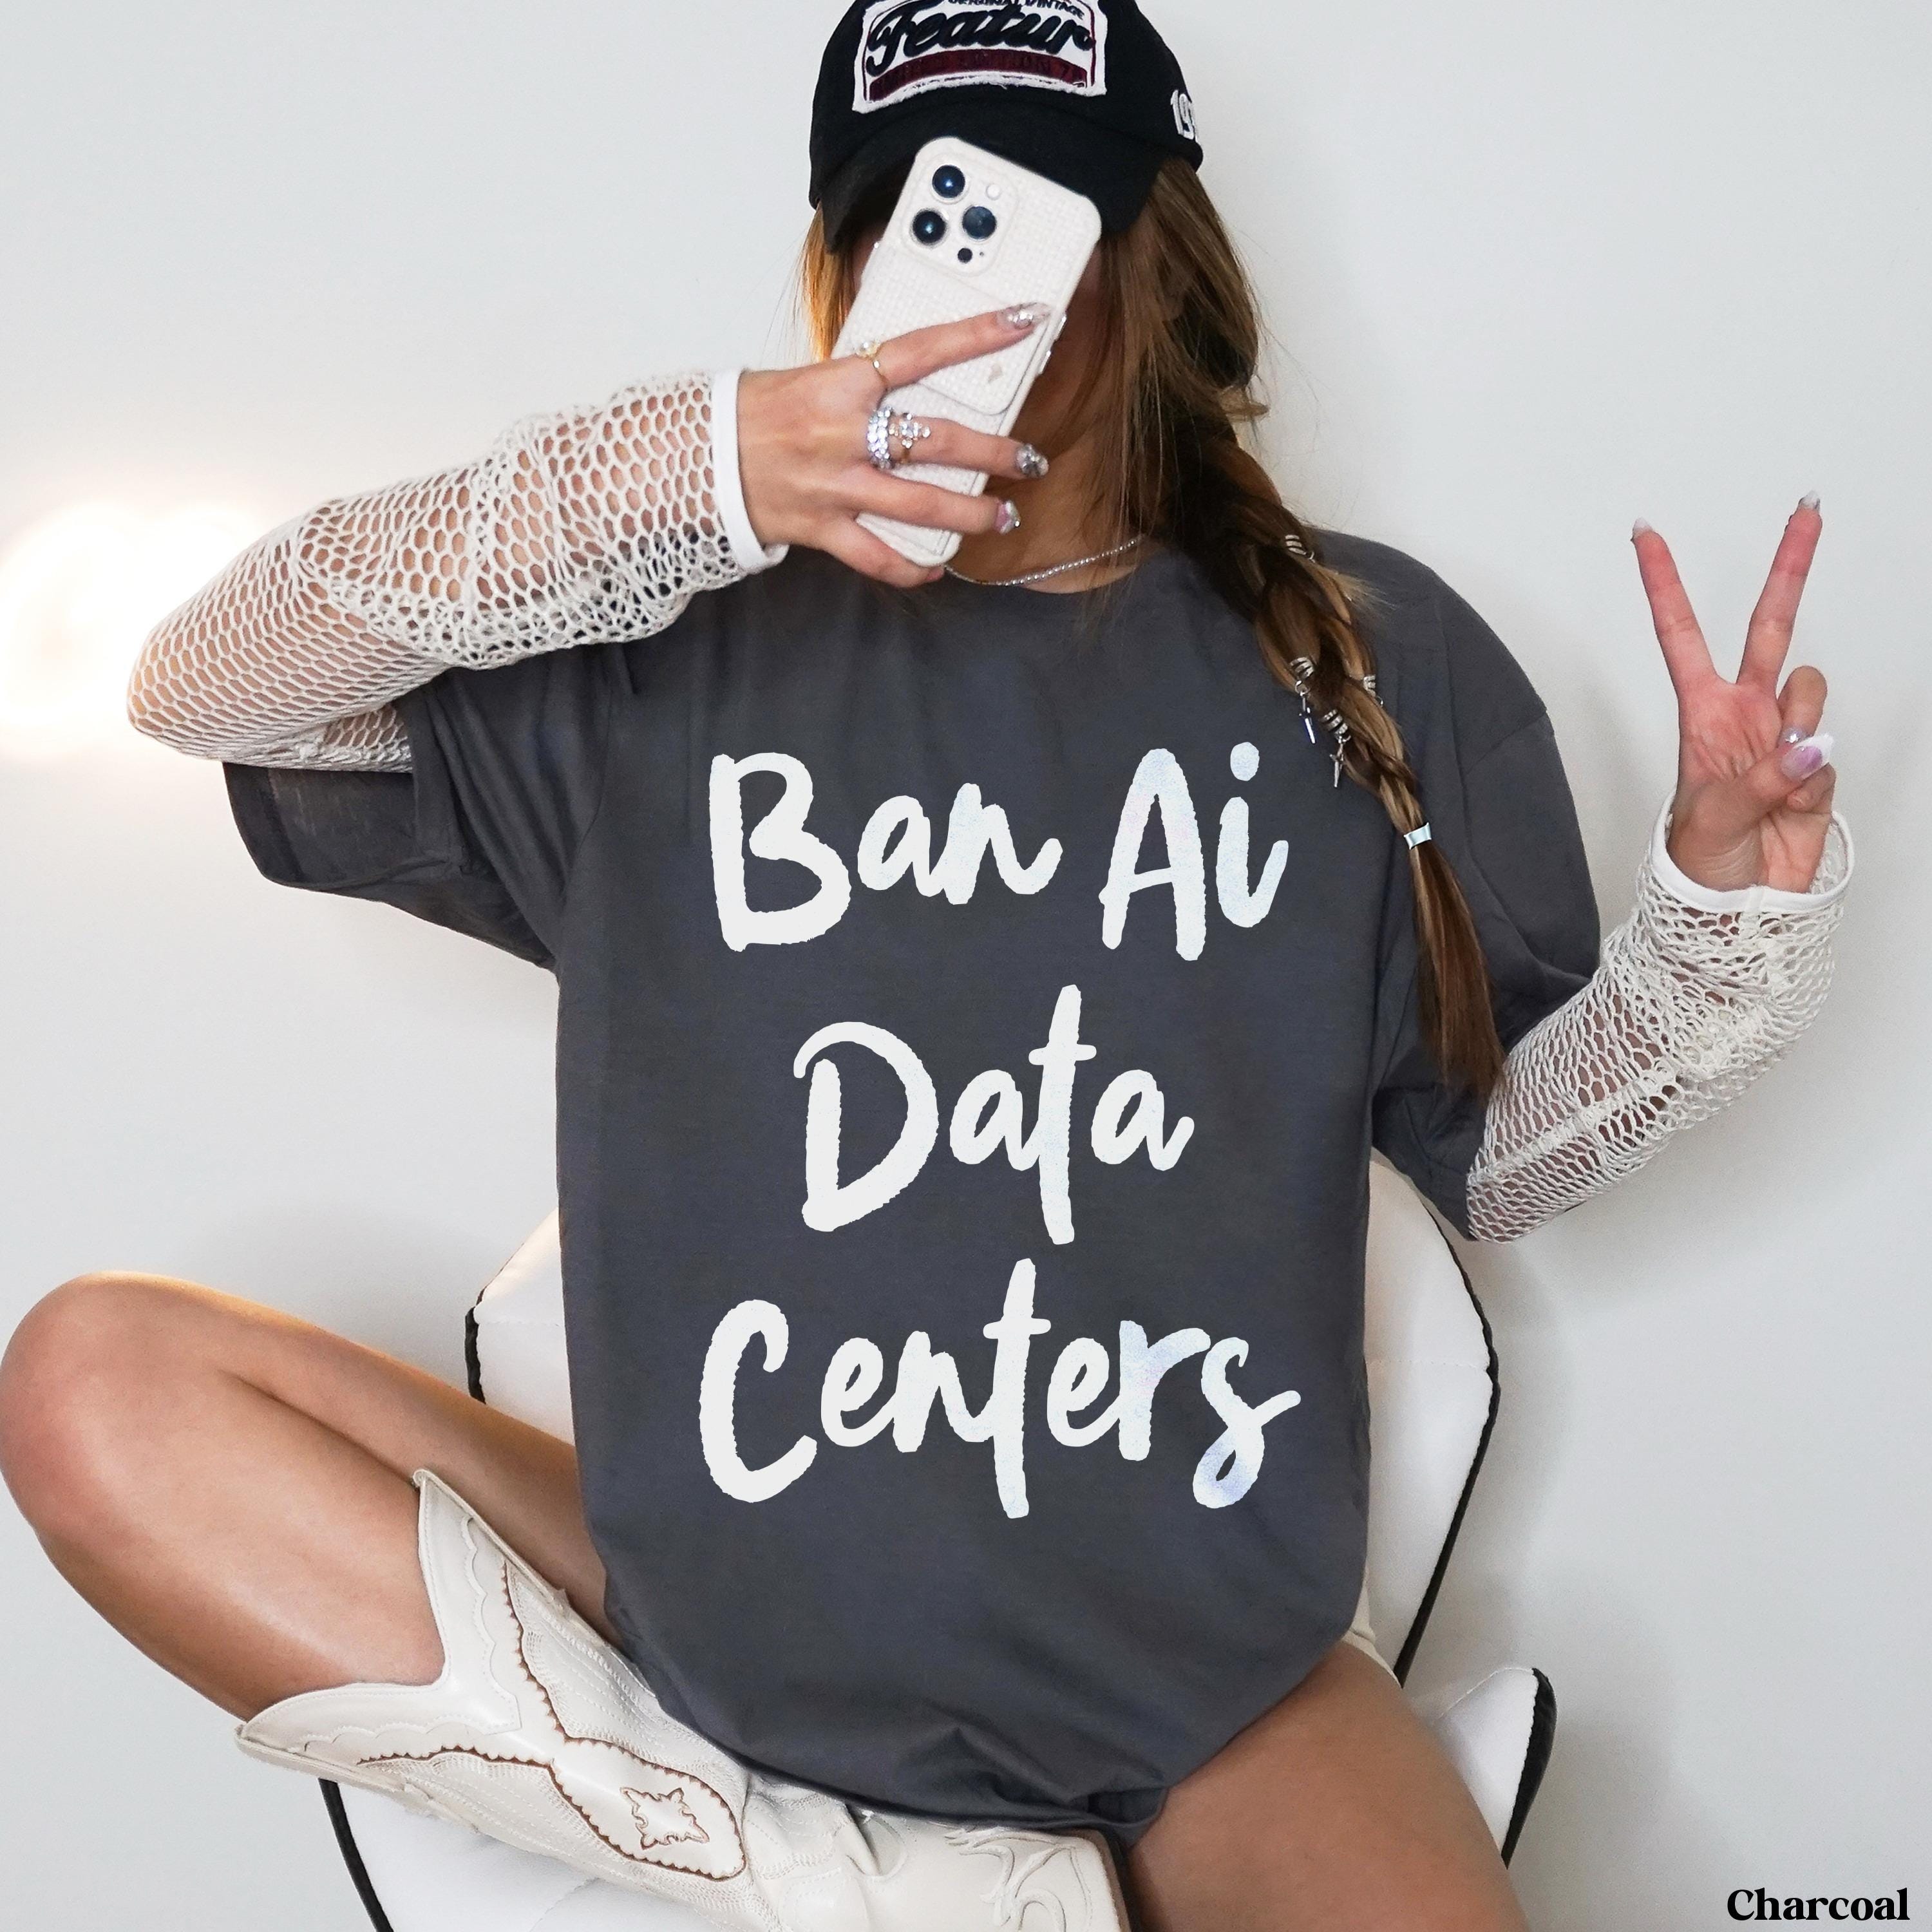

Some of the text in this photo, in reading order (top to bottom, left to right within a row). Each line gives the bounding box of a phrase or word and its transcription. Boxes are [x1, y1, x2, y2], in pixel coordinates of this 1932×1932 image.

[709, 742, 1289, 961] Ban Ai
[793, 985, 1195, 1245] Data
[699, 1258, 1302, 1519] Centers
